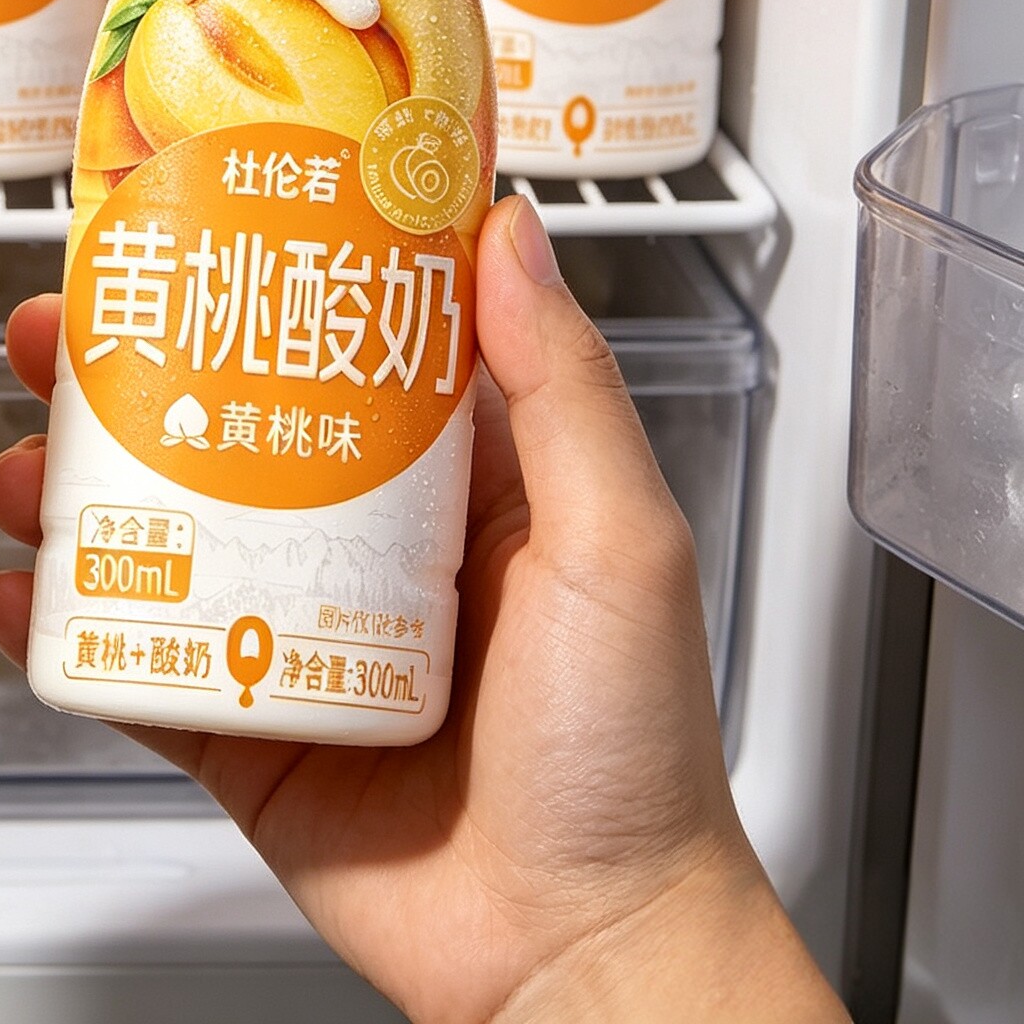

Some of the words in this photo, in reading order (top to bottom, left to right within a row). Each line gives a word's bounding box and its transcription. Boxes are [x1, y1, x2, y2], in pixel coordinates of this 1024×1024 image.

[221, 148, 341, 205] 杜伦若
[83, 220, 462, 397] 黄桃酸奶
[216, 400, 364, 464] 黄桃味
[82, 550, 180, 598] 300mL
[74, 629, 213, 680] 黄桃+酸奶
